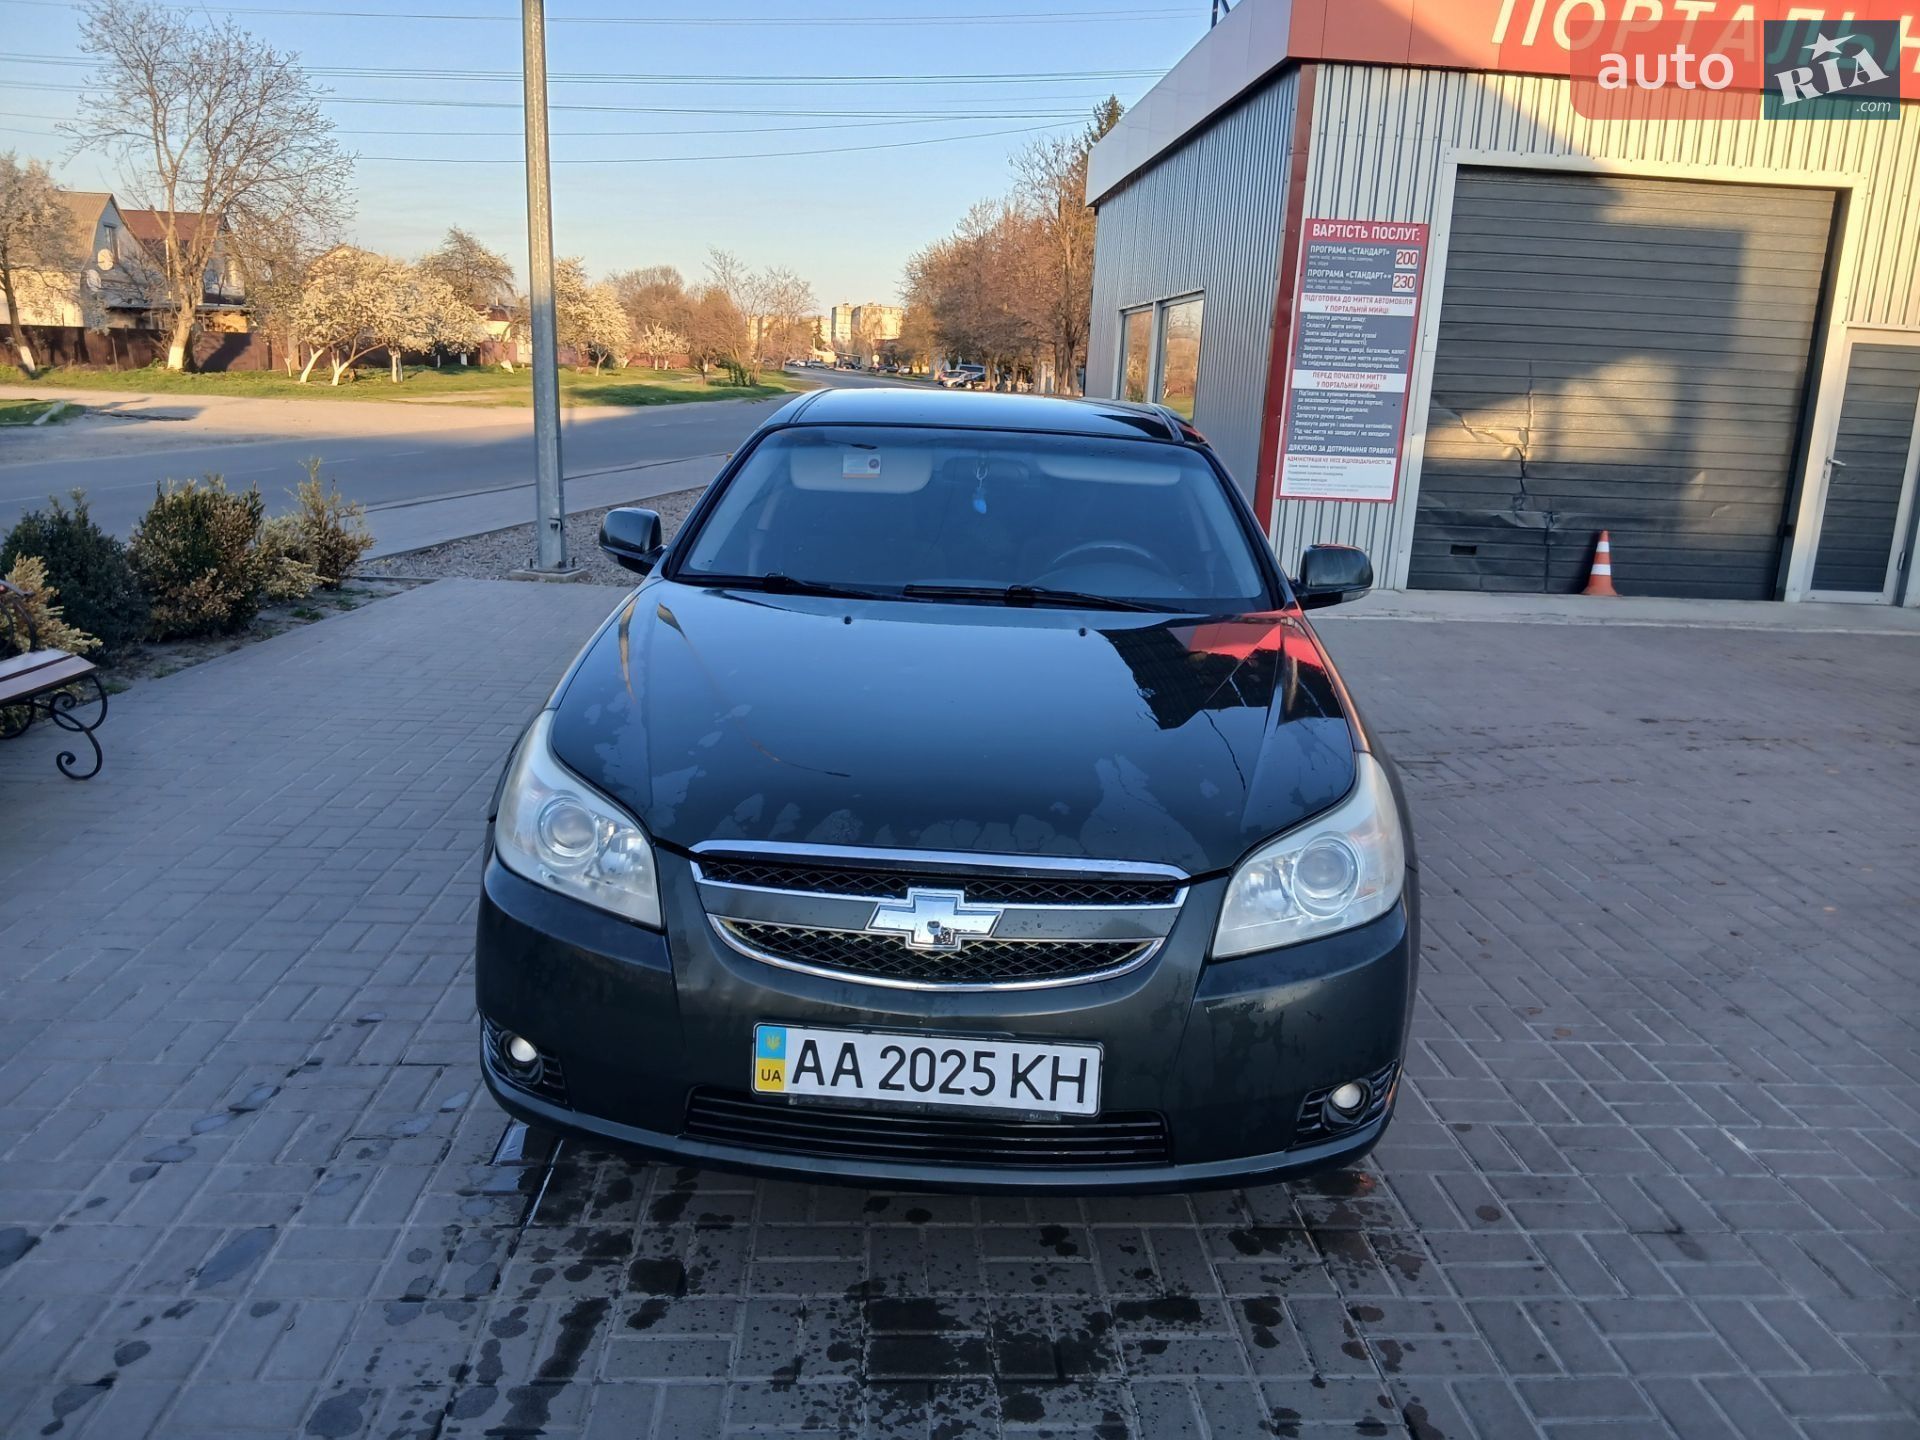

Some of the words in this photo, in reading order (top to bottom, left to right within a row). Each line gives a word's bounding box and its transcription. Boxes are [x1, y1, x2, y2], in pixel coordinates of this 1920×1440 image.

[1312, 223, 1368, 239] ВАРТІСТЬ
[1371, 226, 1421, 241] ПОСЛУГ:
[1310, 245, 1347, 255] ПРОГРАМА
[1396, 251, 1418, 265] 200
[1307, 268, 1344, 278] ПРОГРАМА
[1393, 275, 1416, 288] 230
[761, 1069, 782, 1083] UA
[791, 1039, 864, 1089] AA
[878, 1044, 997, 1097] 2025
[1009, 1052, 1088, 1104] KH
